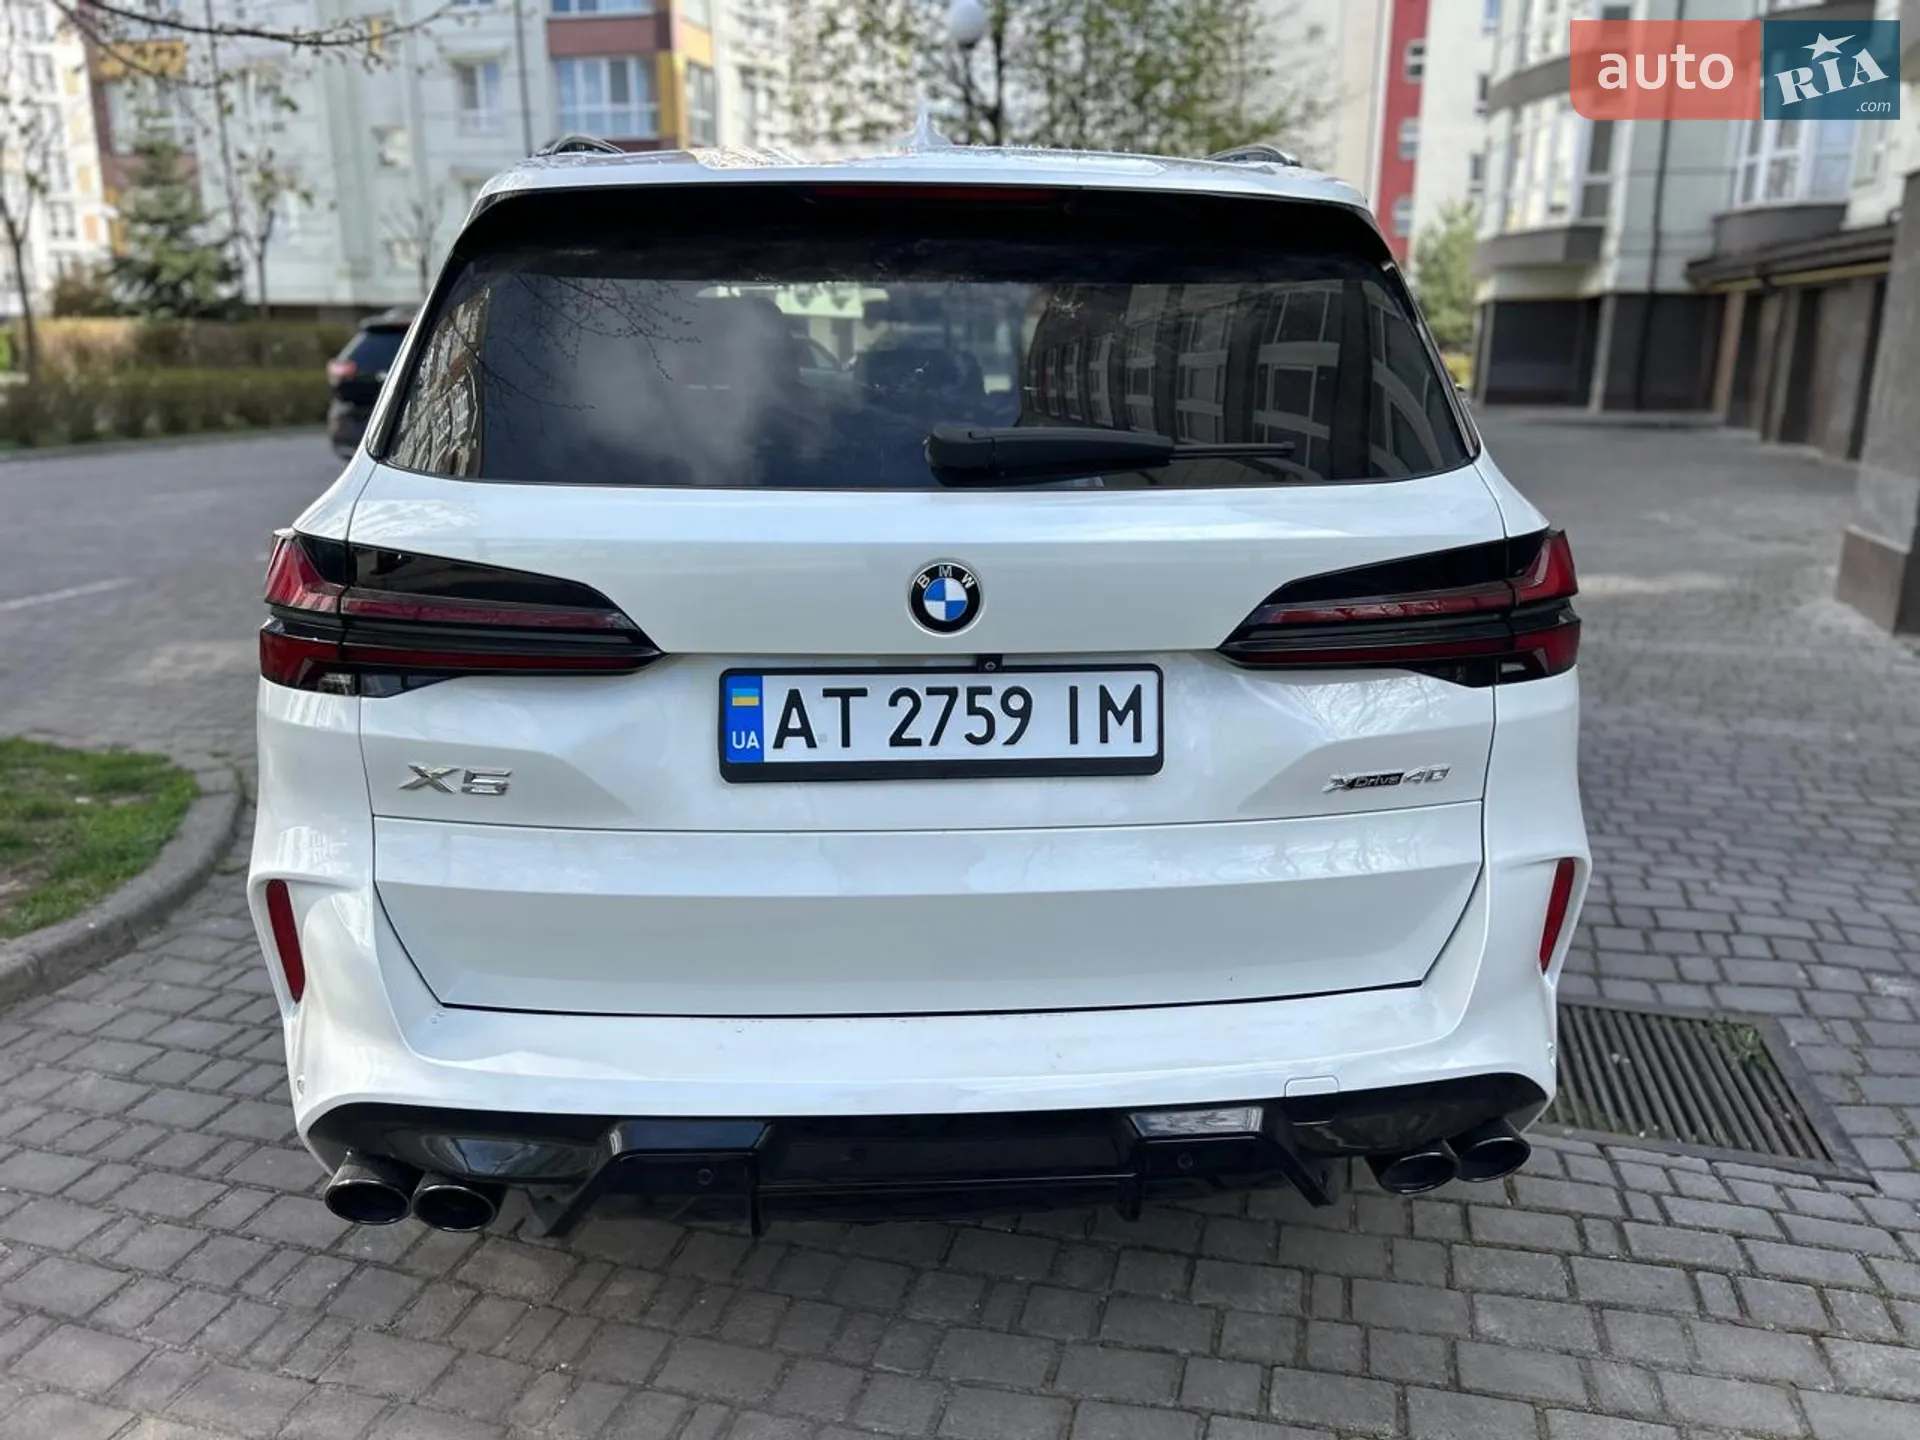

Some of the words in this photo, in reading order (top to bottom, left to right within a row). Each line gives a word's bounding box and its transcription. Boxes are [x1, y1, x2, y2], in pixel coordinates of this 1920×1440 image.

[917, 565, 975, 589] BMW
[772, 687, 868, 750] AT
[887, 685, 1034, 748] 2759
[1068, 683, 1143, 745] IM
[731, 731, 760, 750] UA
[398, 762, 512, 795] X5
